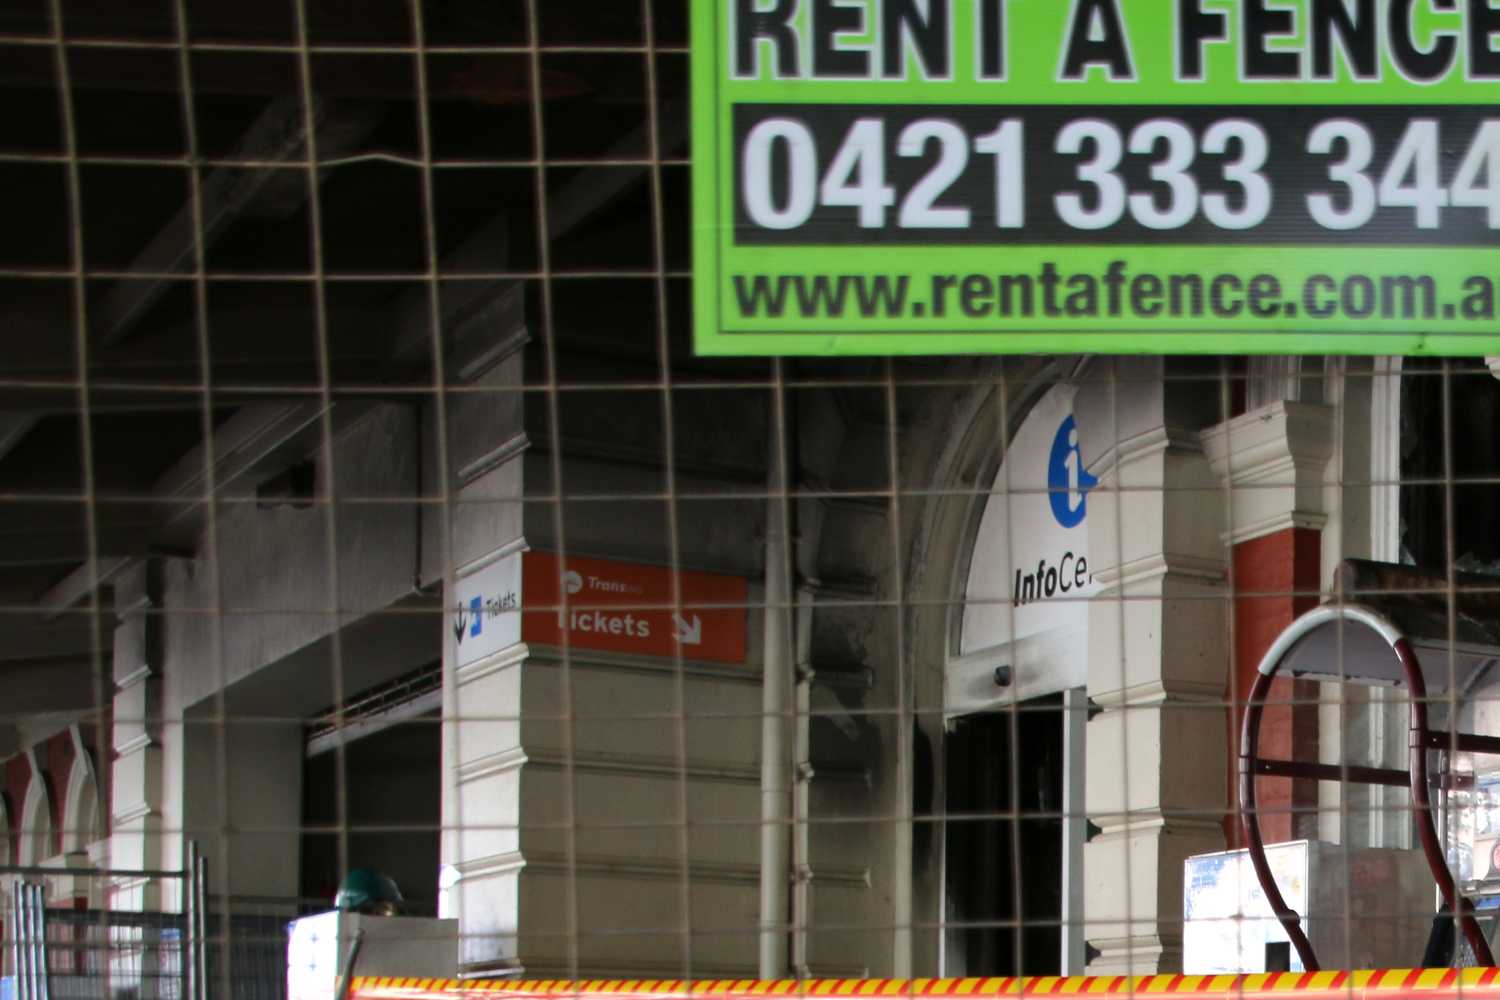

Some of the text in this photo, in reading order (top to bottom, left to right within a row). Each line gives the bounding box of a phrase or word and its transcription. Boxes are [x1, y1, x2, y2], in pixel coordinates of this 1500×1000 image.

[1058, 0, 1137, 82] A
[742, 117, 1026, 230] 0421
[1055, 117, 1272, 230] 333
[485, 589, 517, 619] Tickets
[1013, 551, 1092, 608] InfoCe
[556, 605, 651, 637] Tickets
